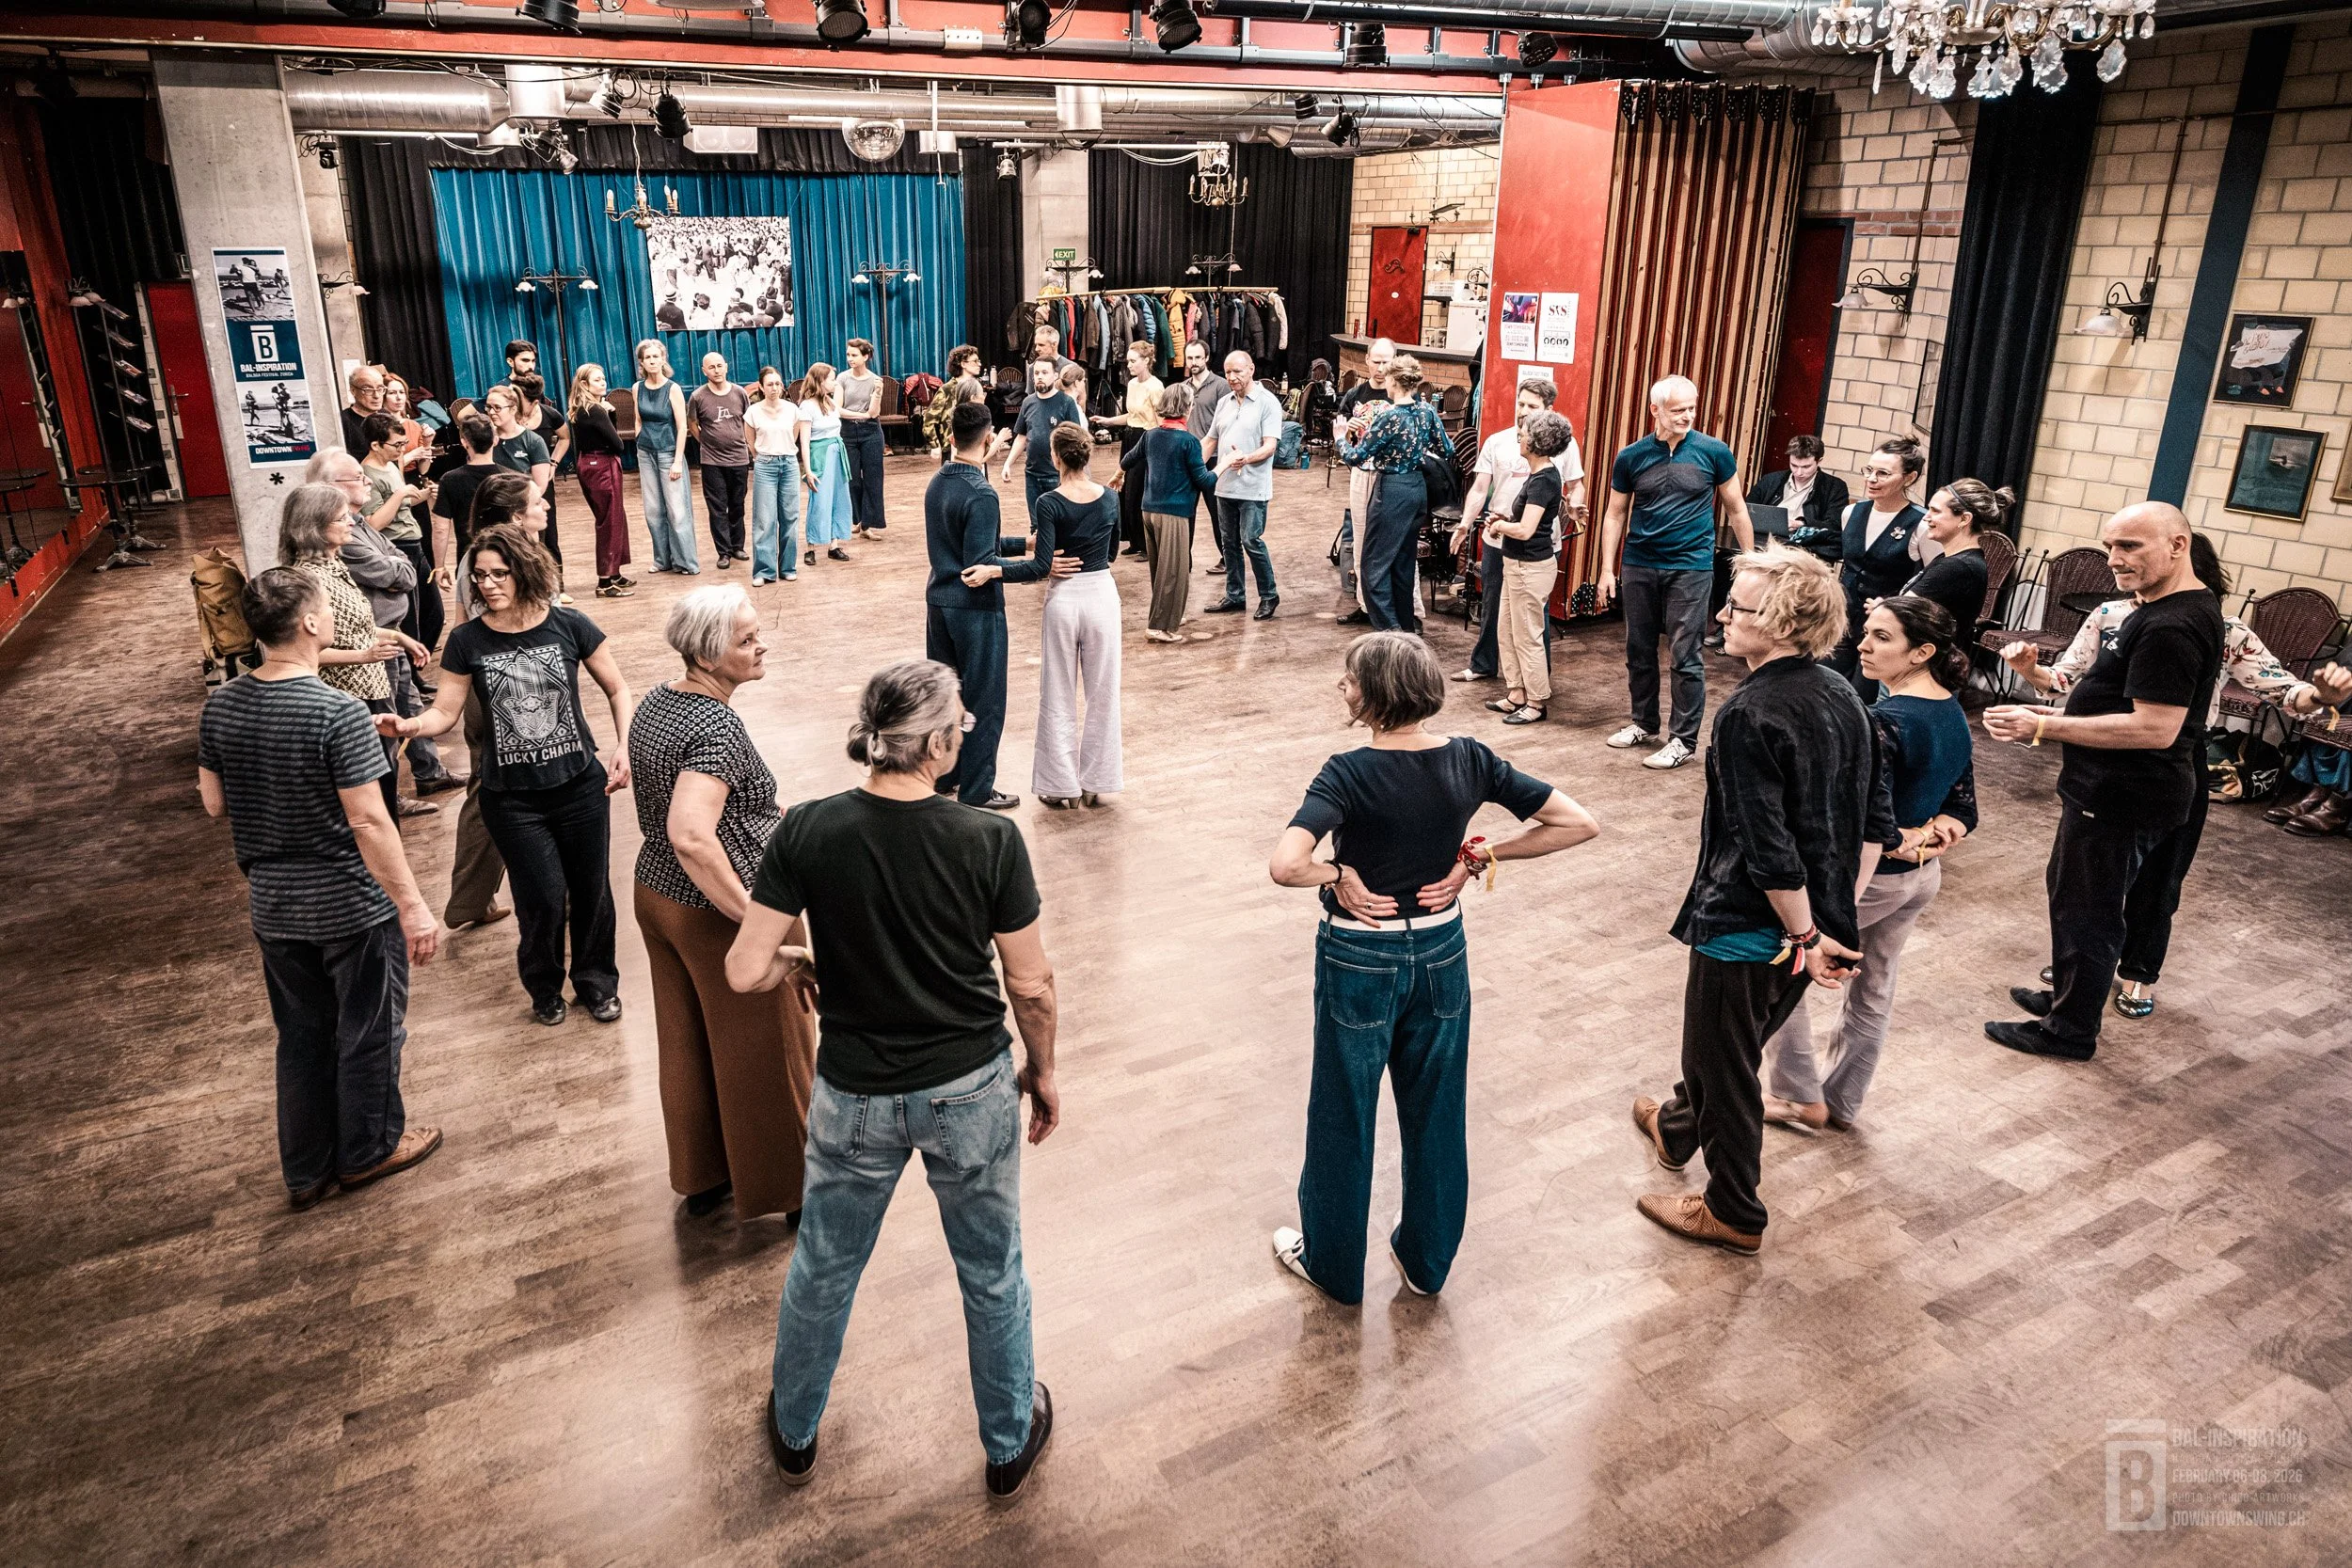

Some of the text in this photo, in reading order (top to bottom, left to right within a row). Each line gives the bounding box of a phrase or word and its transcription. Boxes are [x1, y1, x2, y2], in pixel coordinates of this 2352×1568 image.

[257, 335, 274, 359] B
[240, 362, 297, 372] BAL-INSPIRATION
[497, 740, 583, 767] LUCKY CHARM
